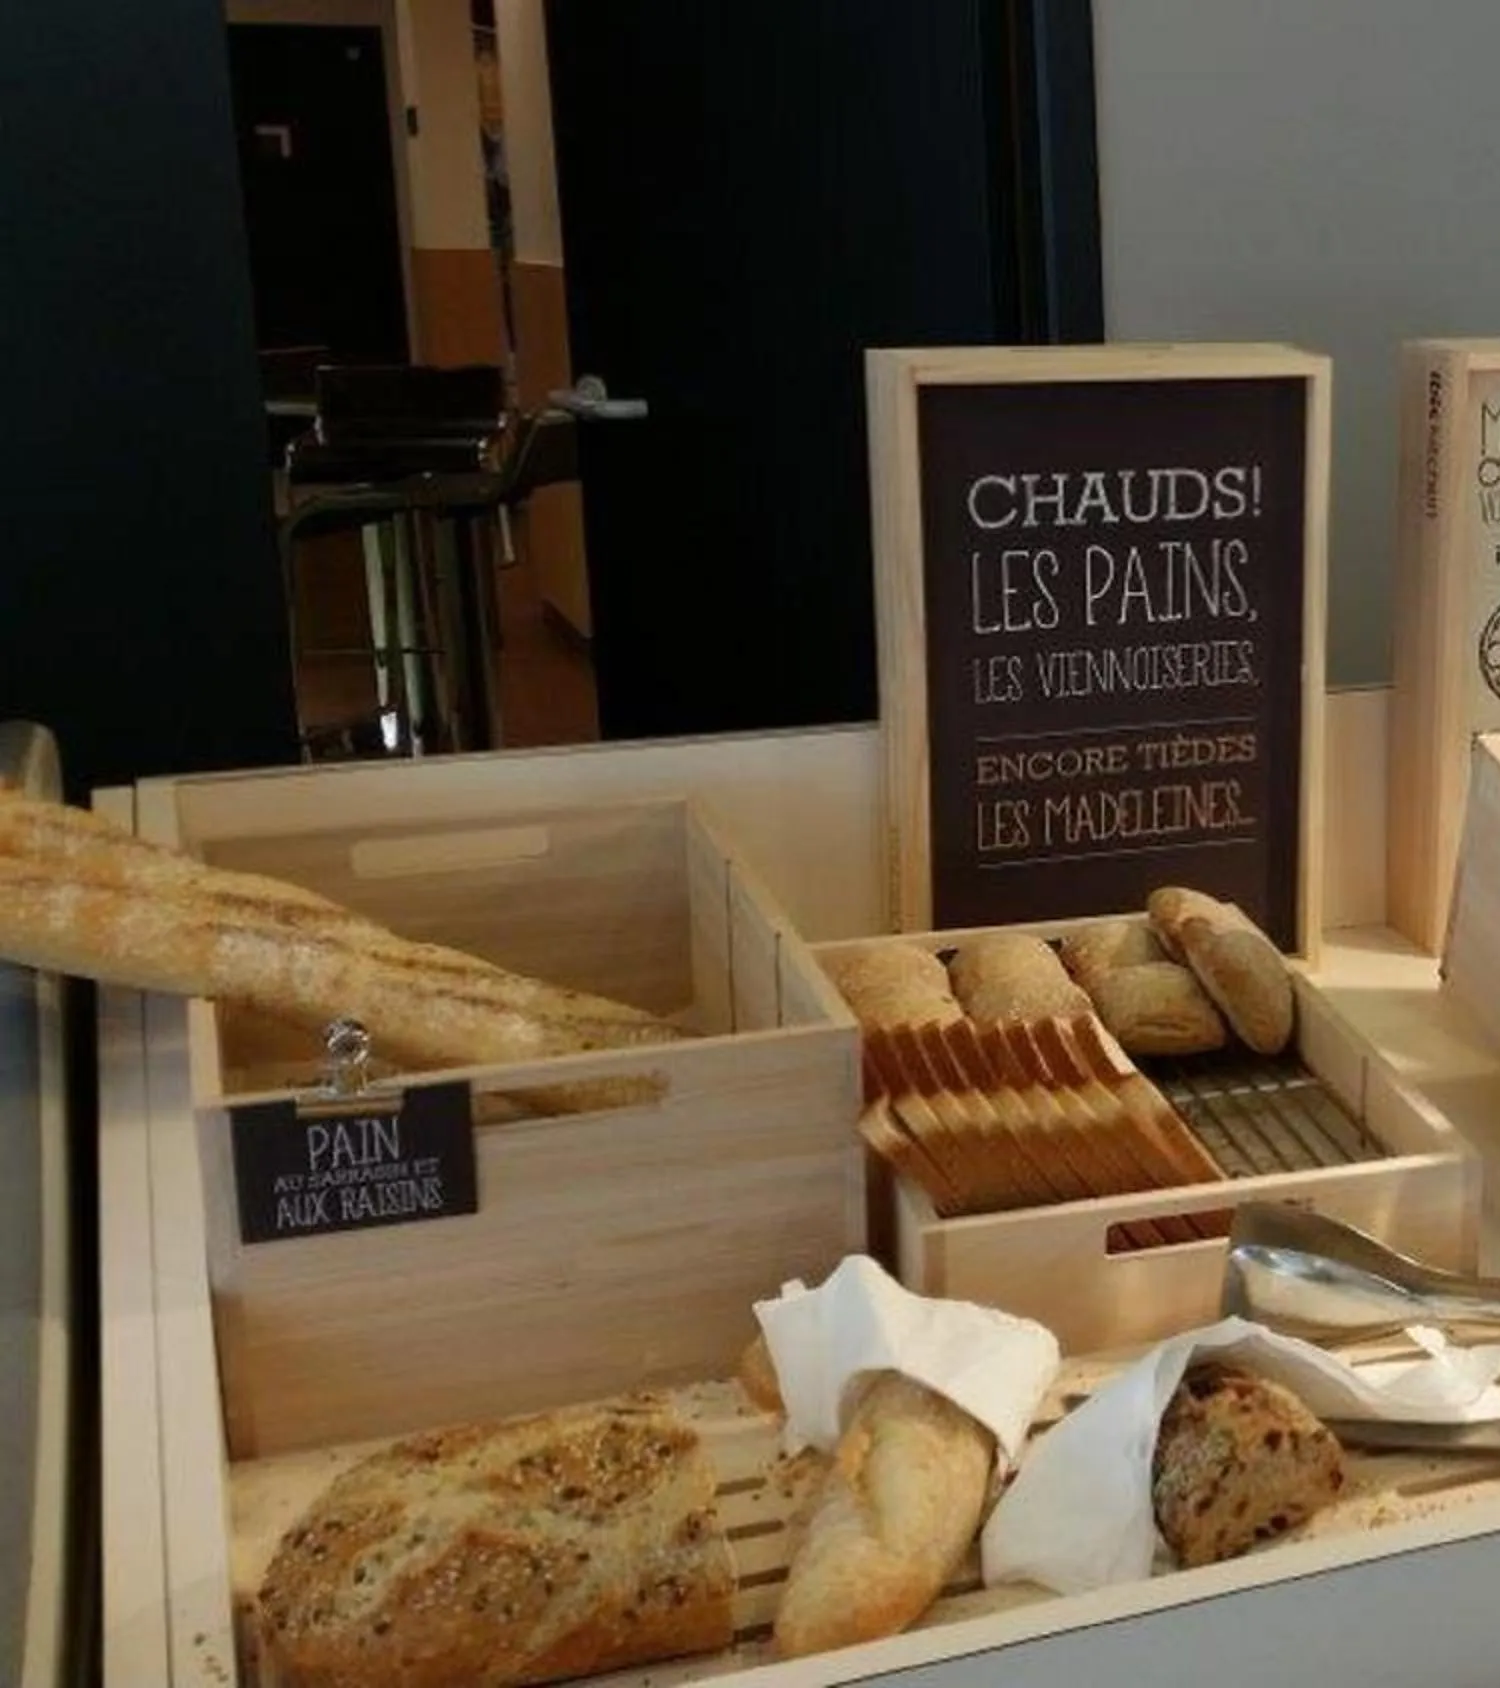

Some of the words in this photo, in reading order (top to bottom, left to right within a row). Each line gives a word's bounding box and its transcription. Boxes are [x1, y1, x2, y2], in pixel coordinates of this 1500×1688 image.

[967, 466, 1263, 530] CHAUDS!
[971, 549, 1060, 635] LES
[1085, 538, 1259, 627] PAINS,
[973, 656, 1024, 704] LES
[977, 745, 1129, 785] ENCORE
[1136, 733, 1258, 773] TIÈDES
[977, 799, 1031, 852] LES
[306, 1115, 399, 1171] PAIN
[276, 1190, 330, 1230] AUX
[340, 1176, 444, 1221] RAISINS
